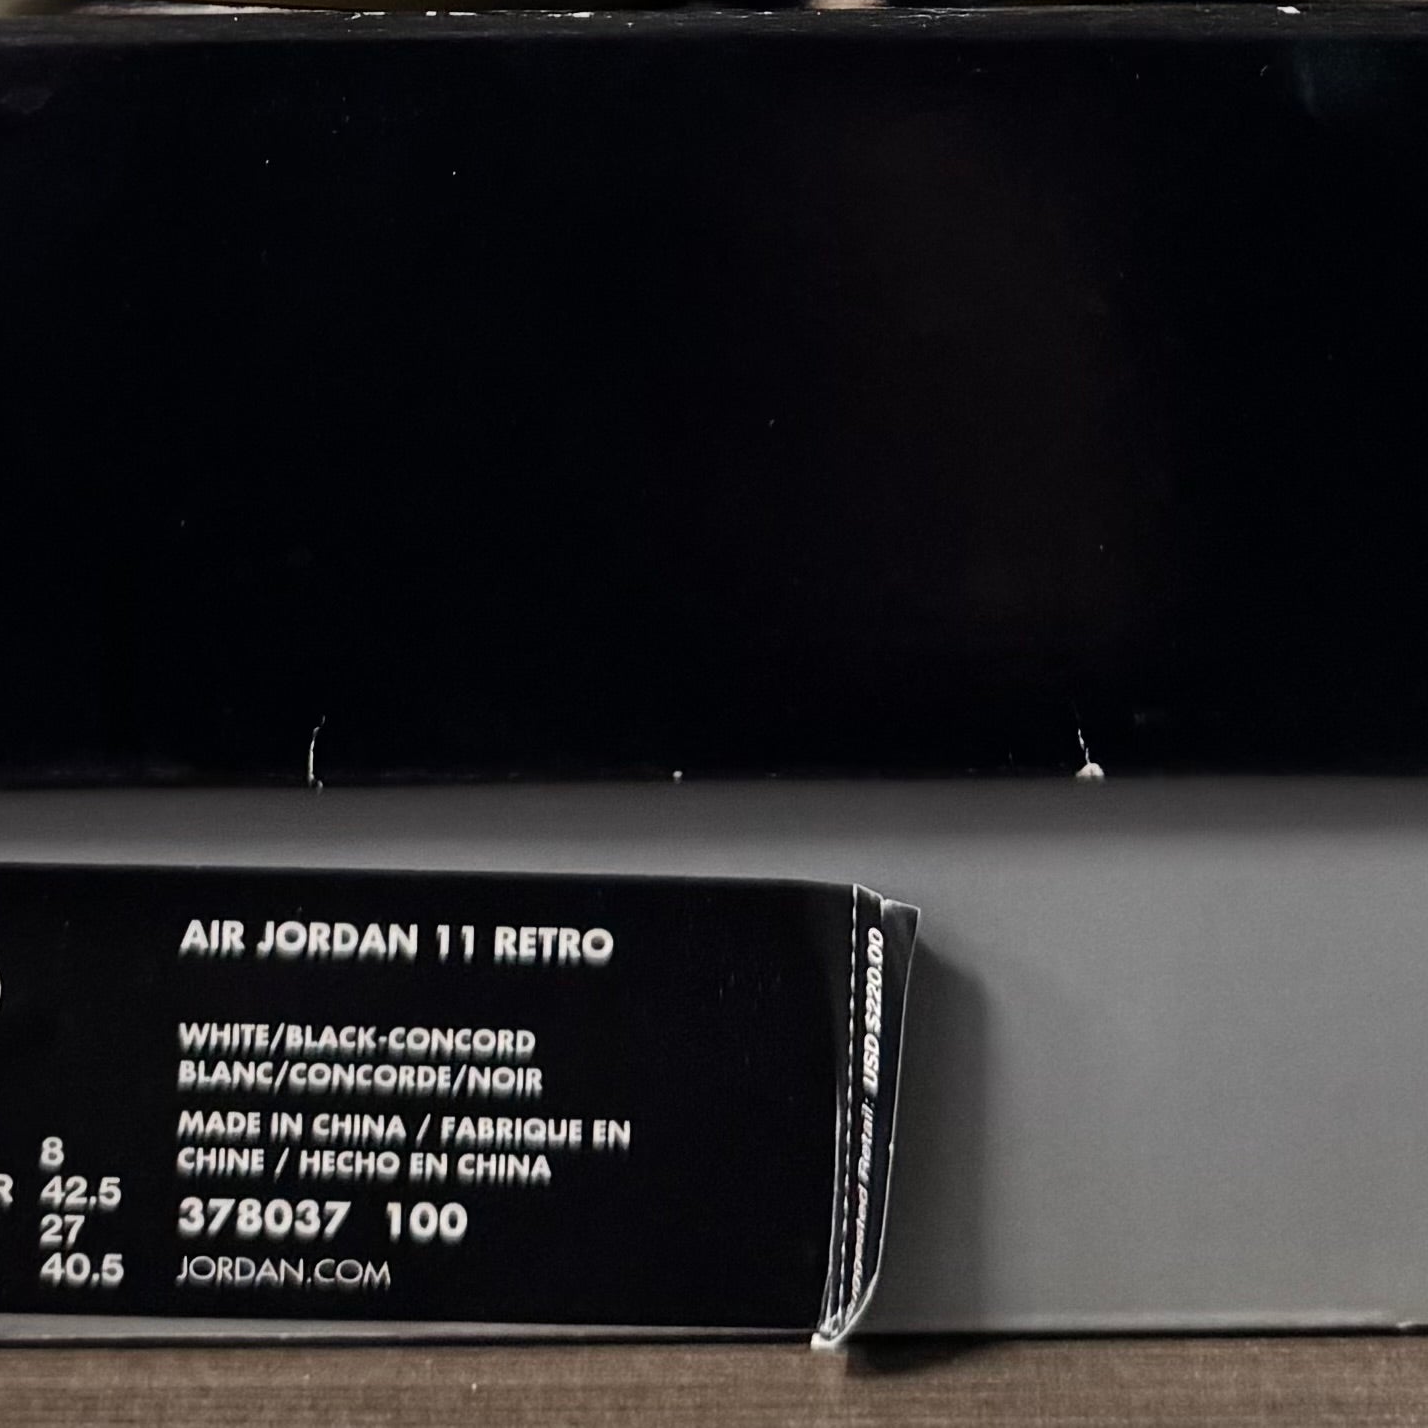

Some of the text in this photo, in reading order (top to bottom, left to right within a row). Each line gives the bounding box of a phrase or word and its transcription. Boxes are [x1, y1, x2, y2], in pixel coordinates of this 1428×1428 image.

[178, 918, 615, 964] AIR JORDAN 11 RETRO
[178, 1022, 537, 1056] WHITE/BLACK-CONCORD
[178, 1060, 544, 1095] BLANC/CONCORDE/NOIR
[862, 1032, 880, 1097] USD
[177, 1110, 262, 1140] MADE
[270, 1112, 304, 1141] IN
[312, 1113, 408, 1143] CHINA
[440, 1116, 584, 1147] FABRIQUE
[592, 1119, 633, 1149] EN
[39, 1136, 66, 1170] 8
[177, 1146, 266, 1176] CHINE
[299, 1149, 402, 1179] HECHO
[409, 1152, 450, 1181] EN
[456, 1153, 553, 1182] CHINA
[39, 1175, 123, 1209] 42.5
[39, 1213, 86, 1246] 27
[178, 1196, 469, 1241] 378037 100
[39, 1252, 125, 1286] 40.5
[176, 1255, 392, 1288] JORDAN.COM
